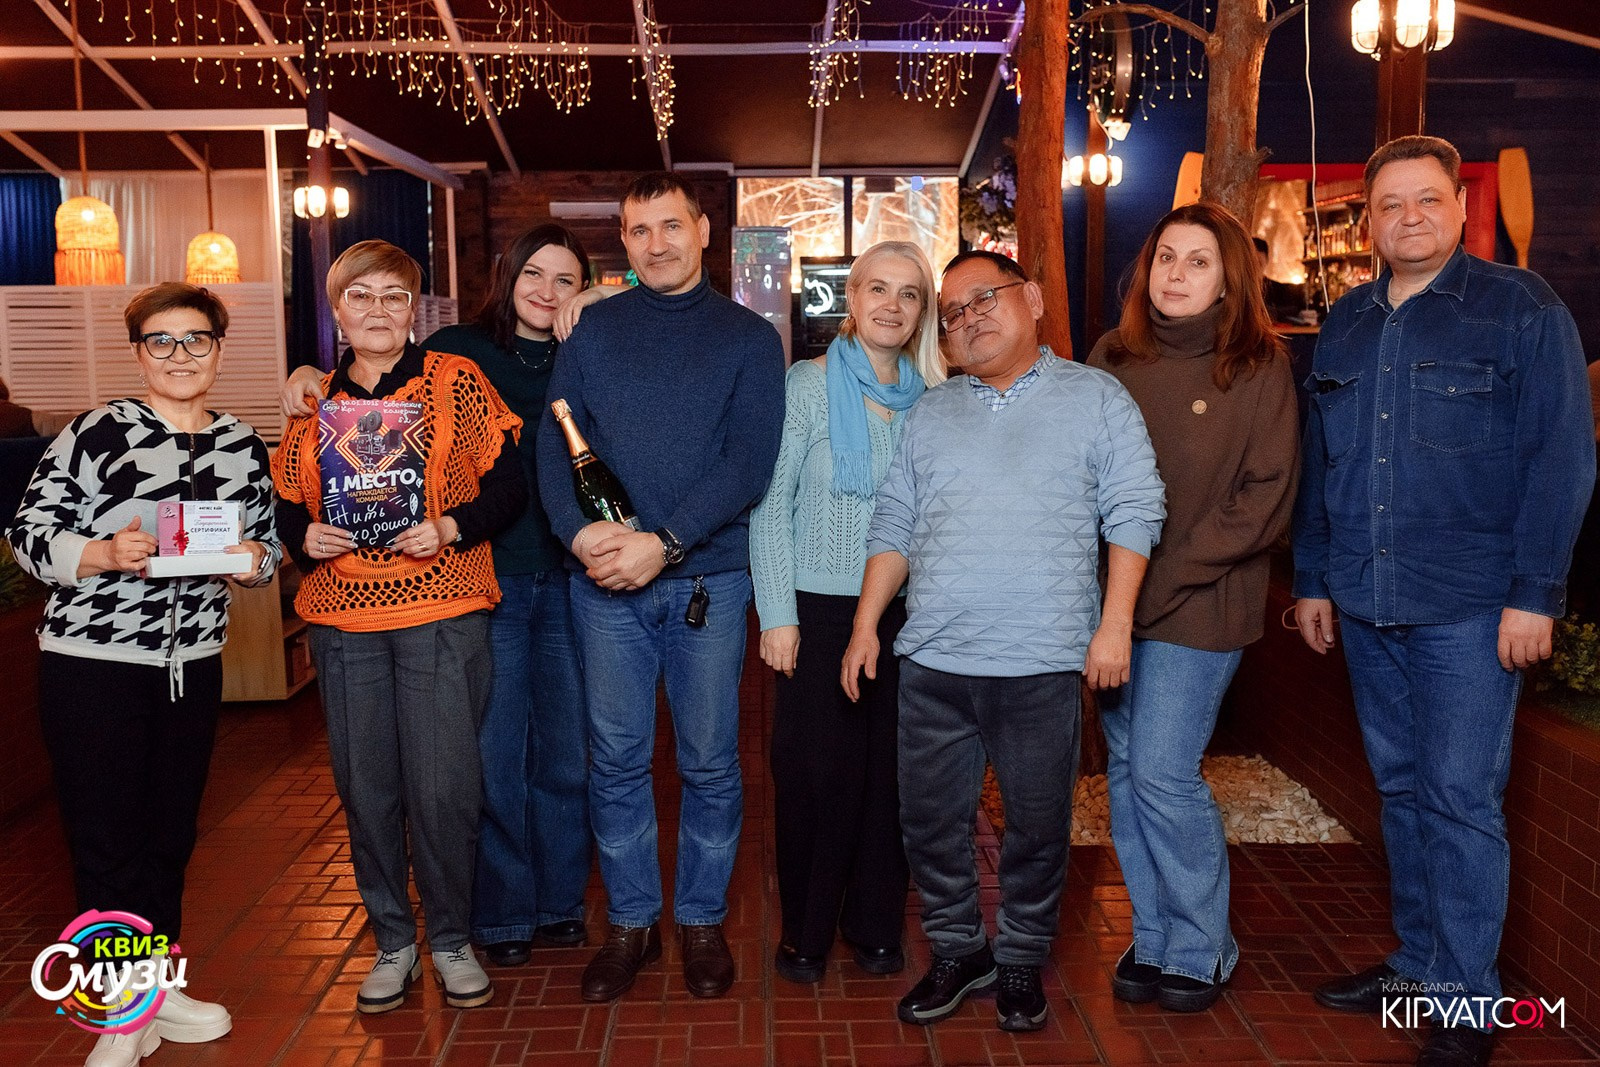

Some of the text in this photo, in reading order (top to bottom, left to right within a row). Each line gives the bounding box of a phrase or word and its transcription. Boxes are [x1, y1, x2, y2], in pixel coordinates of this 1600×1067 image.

[327, 468, 417, 494] 1 МЕСТО
[346, 486, 397, 498] НАГРАЖДАЕТСЯ
[355, 495, 389, 503] КОМАНДА
[327, 502, 386, 526] Жить
[350, 517, 409, 545] хорошо
